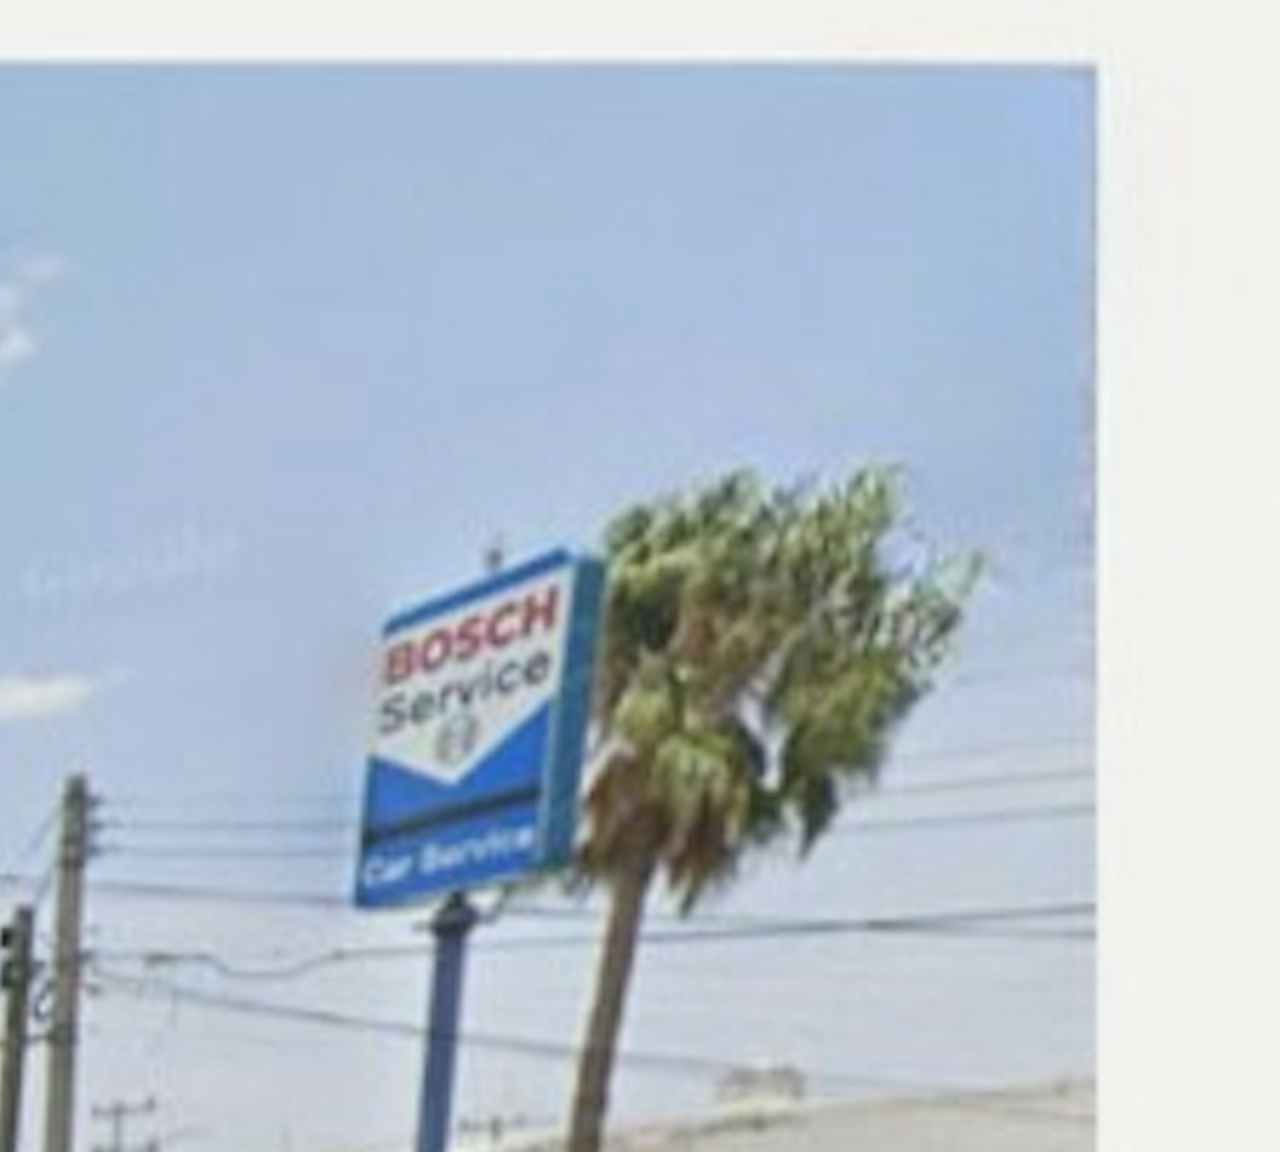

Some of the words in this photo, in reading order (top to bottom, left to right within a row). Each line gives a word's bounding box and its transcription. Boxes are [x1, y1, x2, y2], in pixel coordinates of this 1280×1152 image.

[385, 585, 561, 684] BOSCH
[376, 651, 553, 735] Service
[420, 824, 536, 876] Service
